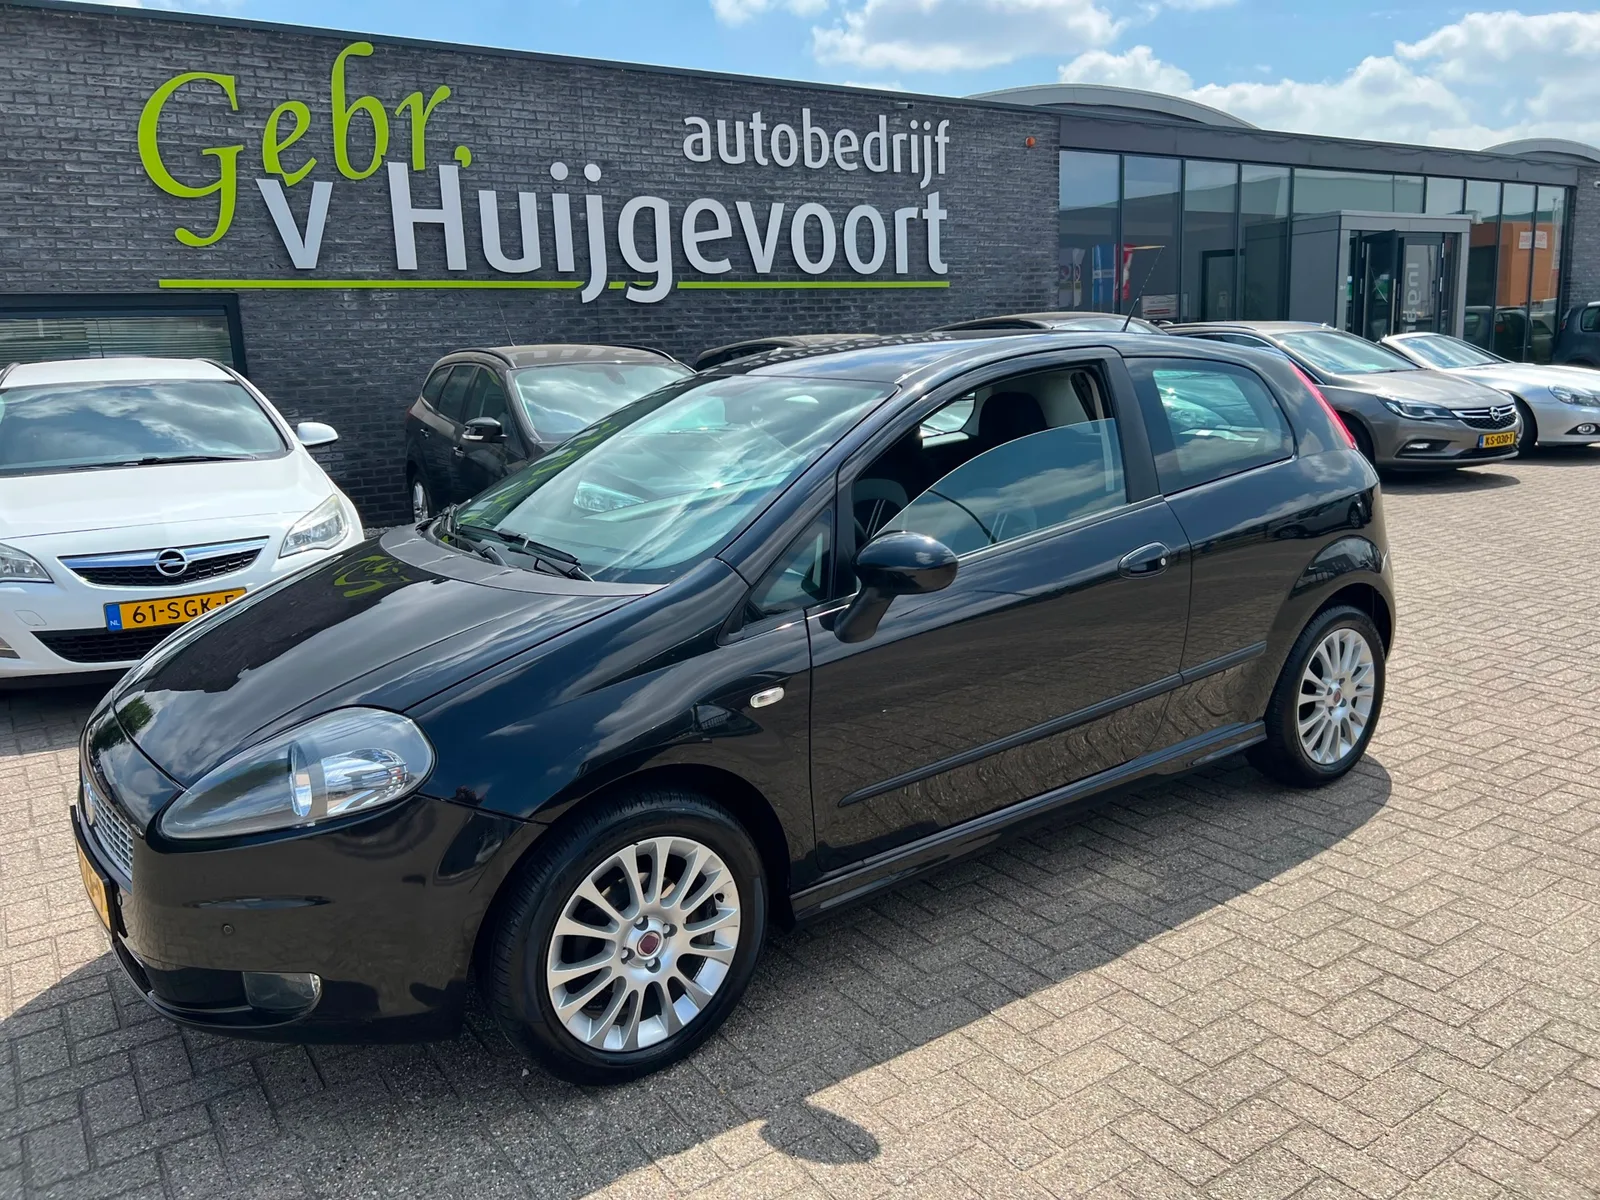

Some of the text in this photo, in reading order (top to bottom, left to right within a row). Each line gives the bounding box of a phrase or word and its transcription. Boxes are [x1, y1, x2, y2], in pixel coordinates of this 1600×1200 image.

[683, 108, 949, 189] autobedrijf
[256, 161, 948, 303] v Huijgevoort
[1485, 433, 1513, 446] KS-030-T
